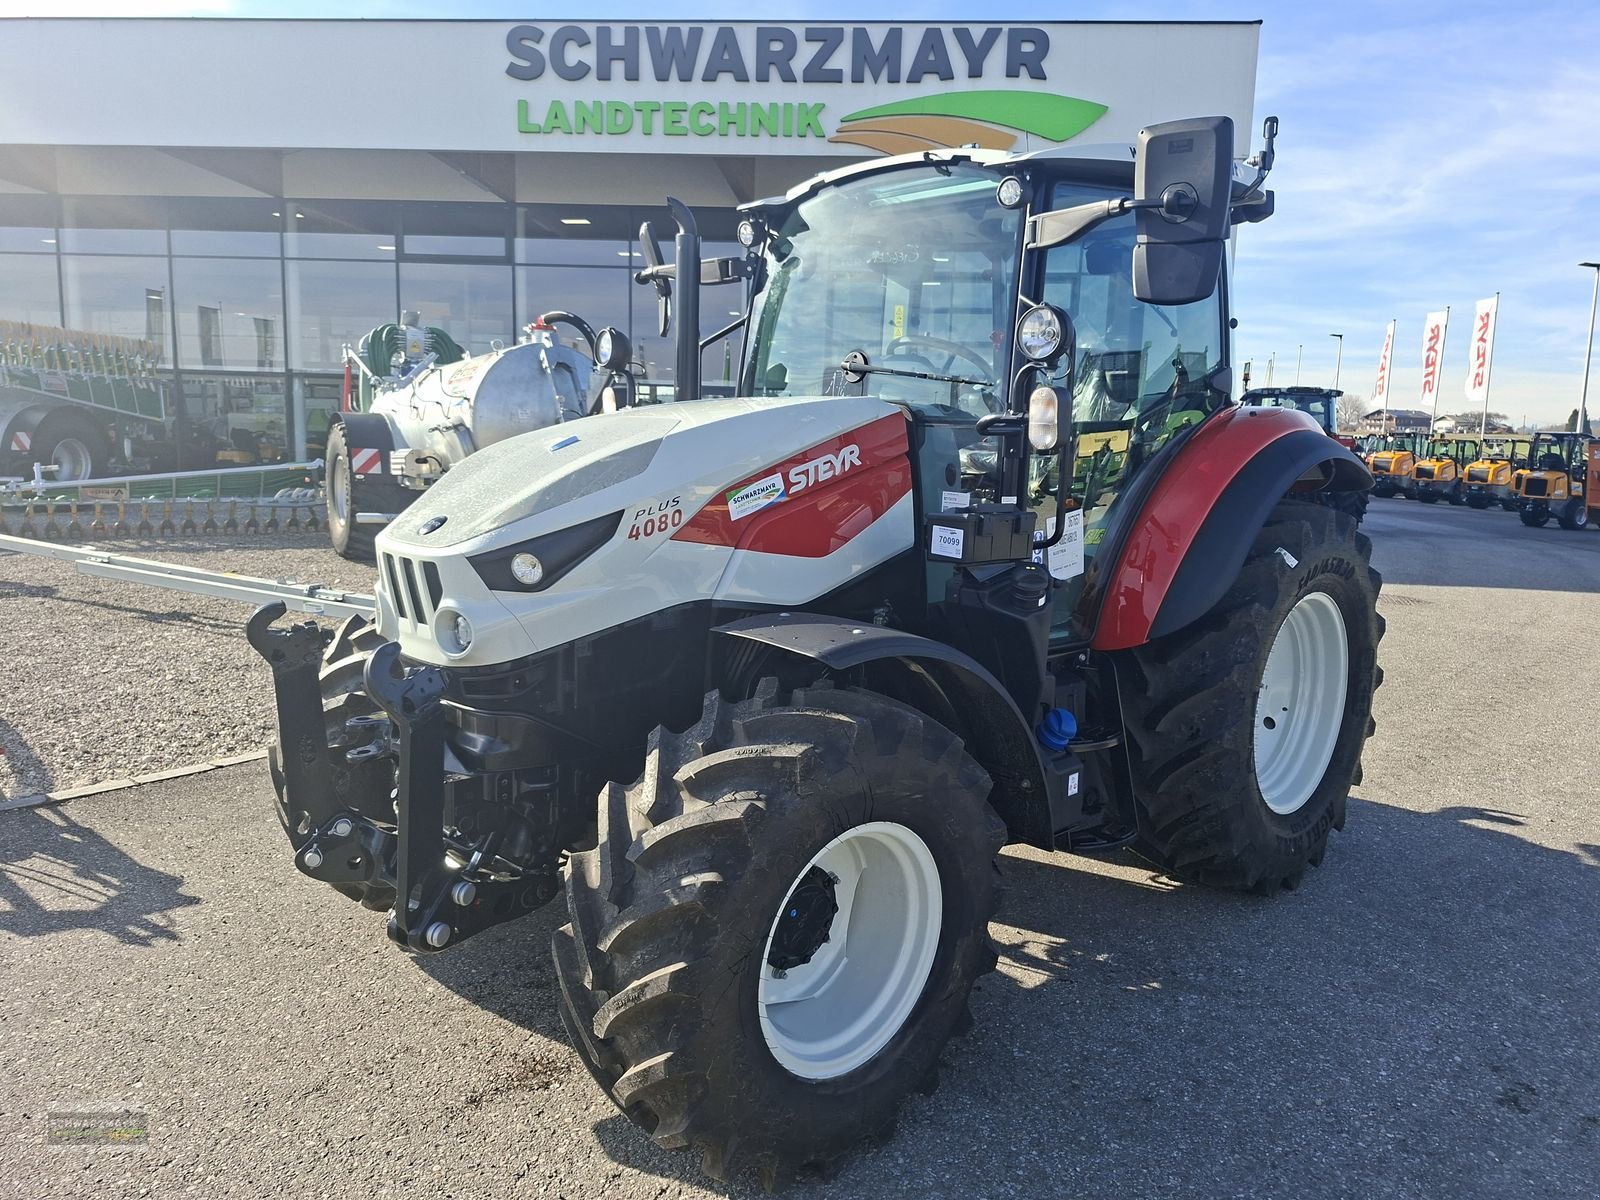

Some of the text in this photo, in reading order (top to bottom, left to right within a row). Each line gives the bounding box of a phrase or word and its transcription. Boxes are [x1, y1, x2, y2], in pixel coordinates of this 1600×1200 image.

[505, 24, 1050, 84] SCHWARZMAYR
[517, 100, 826, 138] LANDTECHNIK
[788, 444, 863, 494] STEYR
[634, 496, 681, 520] PLUS
[733, 482, 776, 504] SCHWARZMAYR
[627, 509, 683, 541] 4080
[939, 535, 960, 547] 70099
